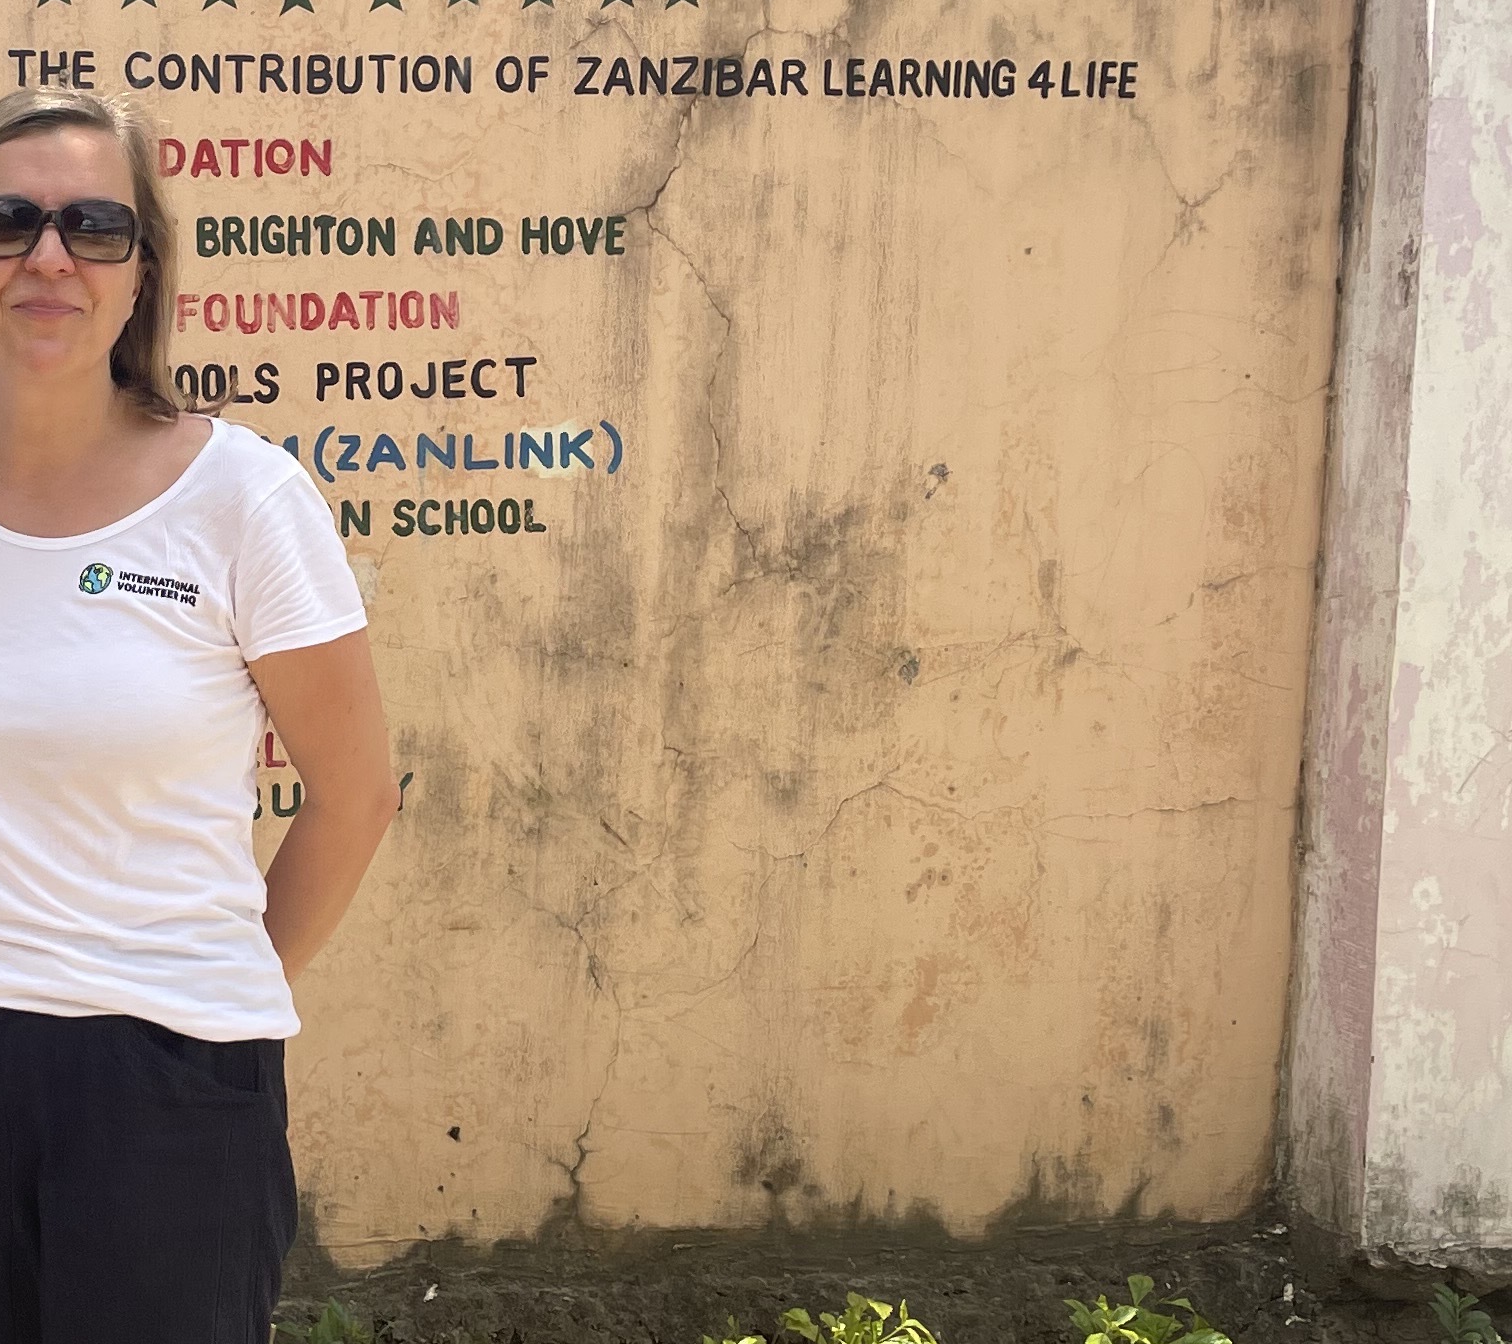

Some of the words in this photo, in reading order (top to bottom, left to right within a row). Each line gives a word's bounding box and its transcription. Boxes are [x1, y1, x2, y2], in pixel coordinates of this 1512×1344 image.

[8, 49, 96, 89] THE
[125, 51, 472, 94] CONTRIBUTION
[495, 56, 550, 94] OF
[574, 56, 808, 97] ZANZIBAR
[823, 58, 1016, 98] LEARNING
[159, 139, 331, 177] DATION
[196, 215, 396, 257] BRIGHTON
[414, 217, 503, 256] AND
[522, 216, 627, 255] HOVE
[176, 291, 460, 334] FOUNDATION
[168, 363, 279, 404] OOLS
[317, 358, 537, 401] PROJECT
[391, 499, 546, 536] SCHOOL
[117, 581, 178, 601] VOLUNTEER
[180, 594, 197, 606] HQ
[119, 571, 200, 594] INTERNATIONAL
